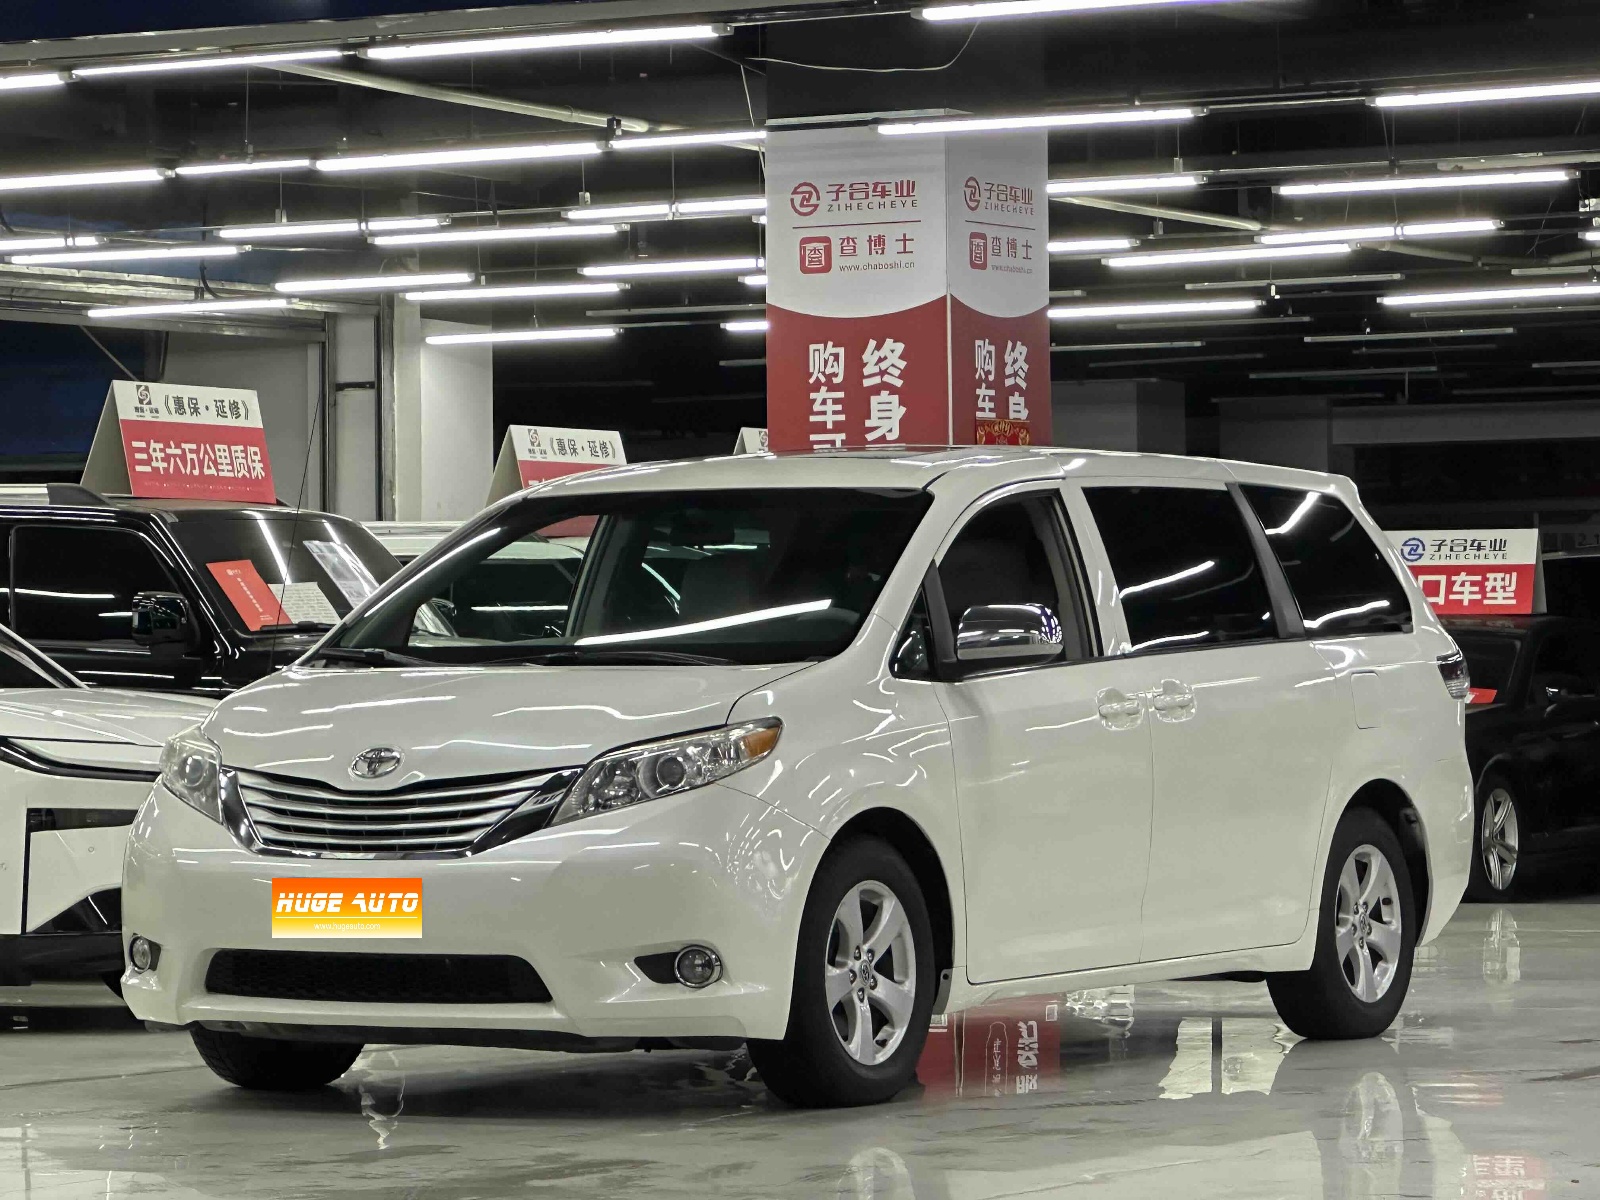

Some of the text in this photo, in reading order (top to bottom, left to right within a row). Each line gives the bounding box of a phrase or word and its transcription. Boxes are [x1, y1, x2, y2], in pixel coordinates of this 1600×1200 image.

[826, 180, 916, 202] 子合车业
[984, 182, 1034, 206] 子合车业
[827, 200, 919, 212] ZIHECHEYE
[984, 202, 1035, 216] ZIHECHEYE
[839, 233, 915, 257] 查博士
[991, 235, 1033, 260] 查博士
[862, 338, 907, 450] 终身
[131, 439, 265, 480] 三年六万公里质保
[1429, 553, 1508, 561] ZIHECHEYE
[1430, 538, 1508, 553] 子合车业
[1418, 571, 1518, 606] 口车型
